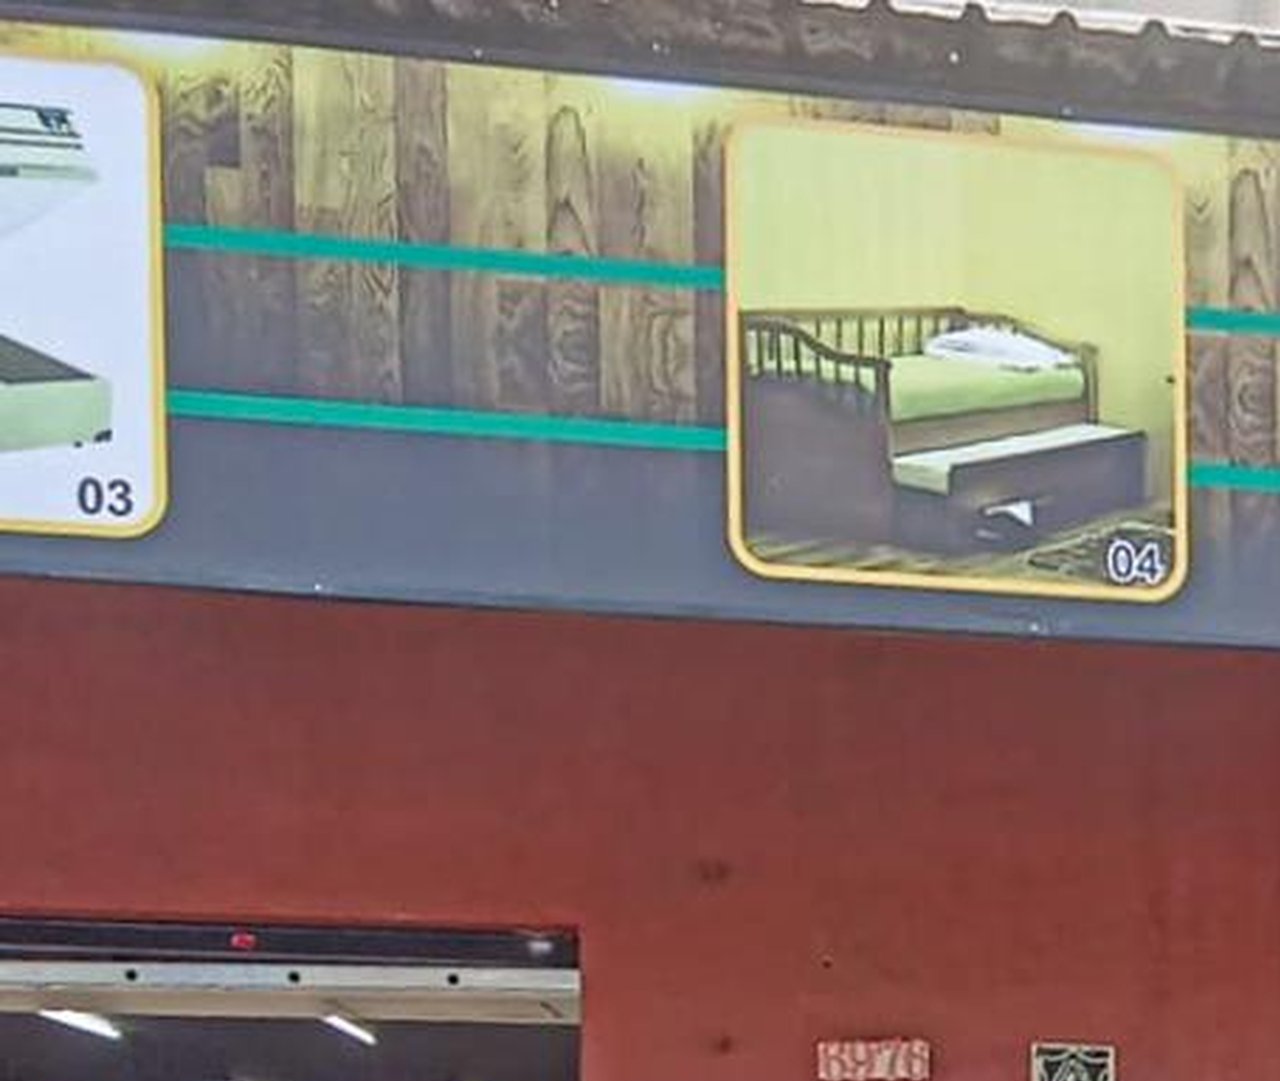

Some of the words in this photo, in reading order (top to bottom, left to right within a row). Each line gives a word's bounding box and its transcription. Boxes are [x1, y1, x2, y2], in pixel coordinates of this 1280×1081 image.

[78, 476, 134, 517] 03
[1109, 541, 1163, 584] 04
[823, 1041, 927, 1079] 6976
